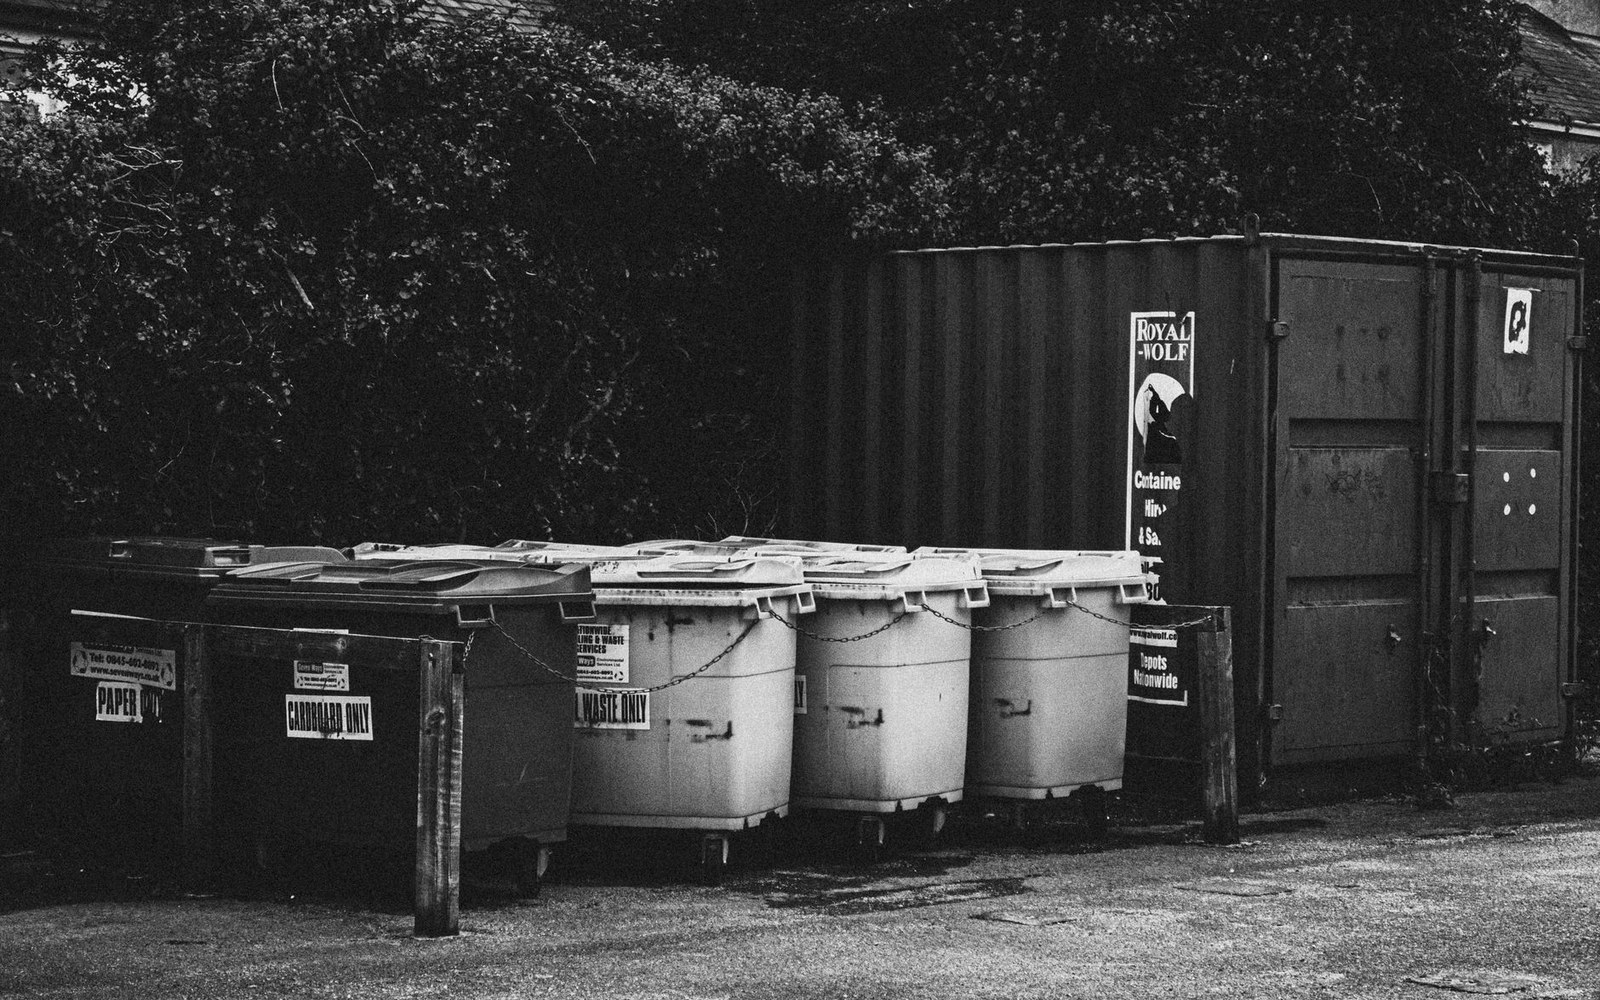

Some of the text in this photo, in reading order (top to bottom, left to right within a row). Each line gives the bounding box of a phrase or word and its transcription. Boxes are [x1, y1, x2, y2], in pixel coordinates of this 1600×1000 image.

[1137, 319, 1191, 342] ROYAL
[1145, 526, 1162, 546] Sa
[577, 625, 611, 635] TIONWIDE
[601, 635, 625, 645] WASTE
[98, 687, 136, 716] PAPER
[582, 692, 618, 723] WASTE
[621, 693, 647, 724] ONLY
[288, 701, 369, 733] CARDBOARD ONLY
